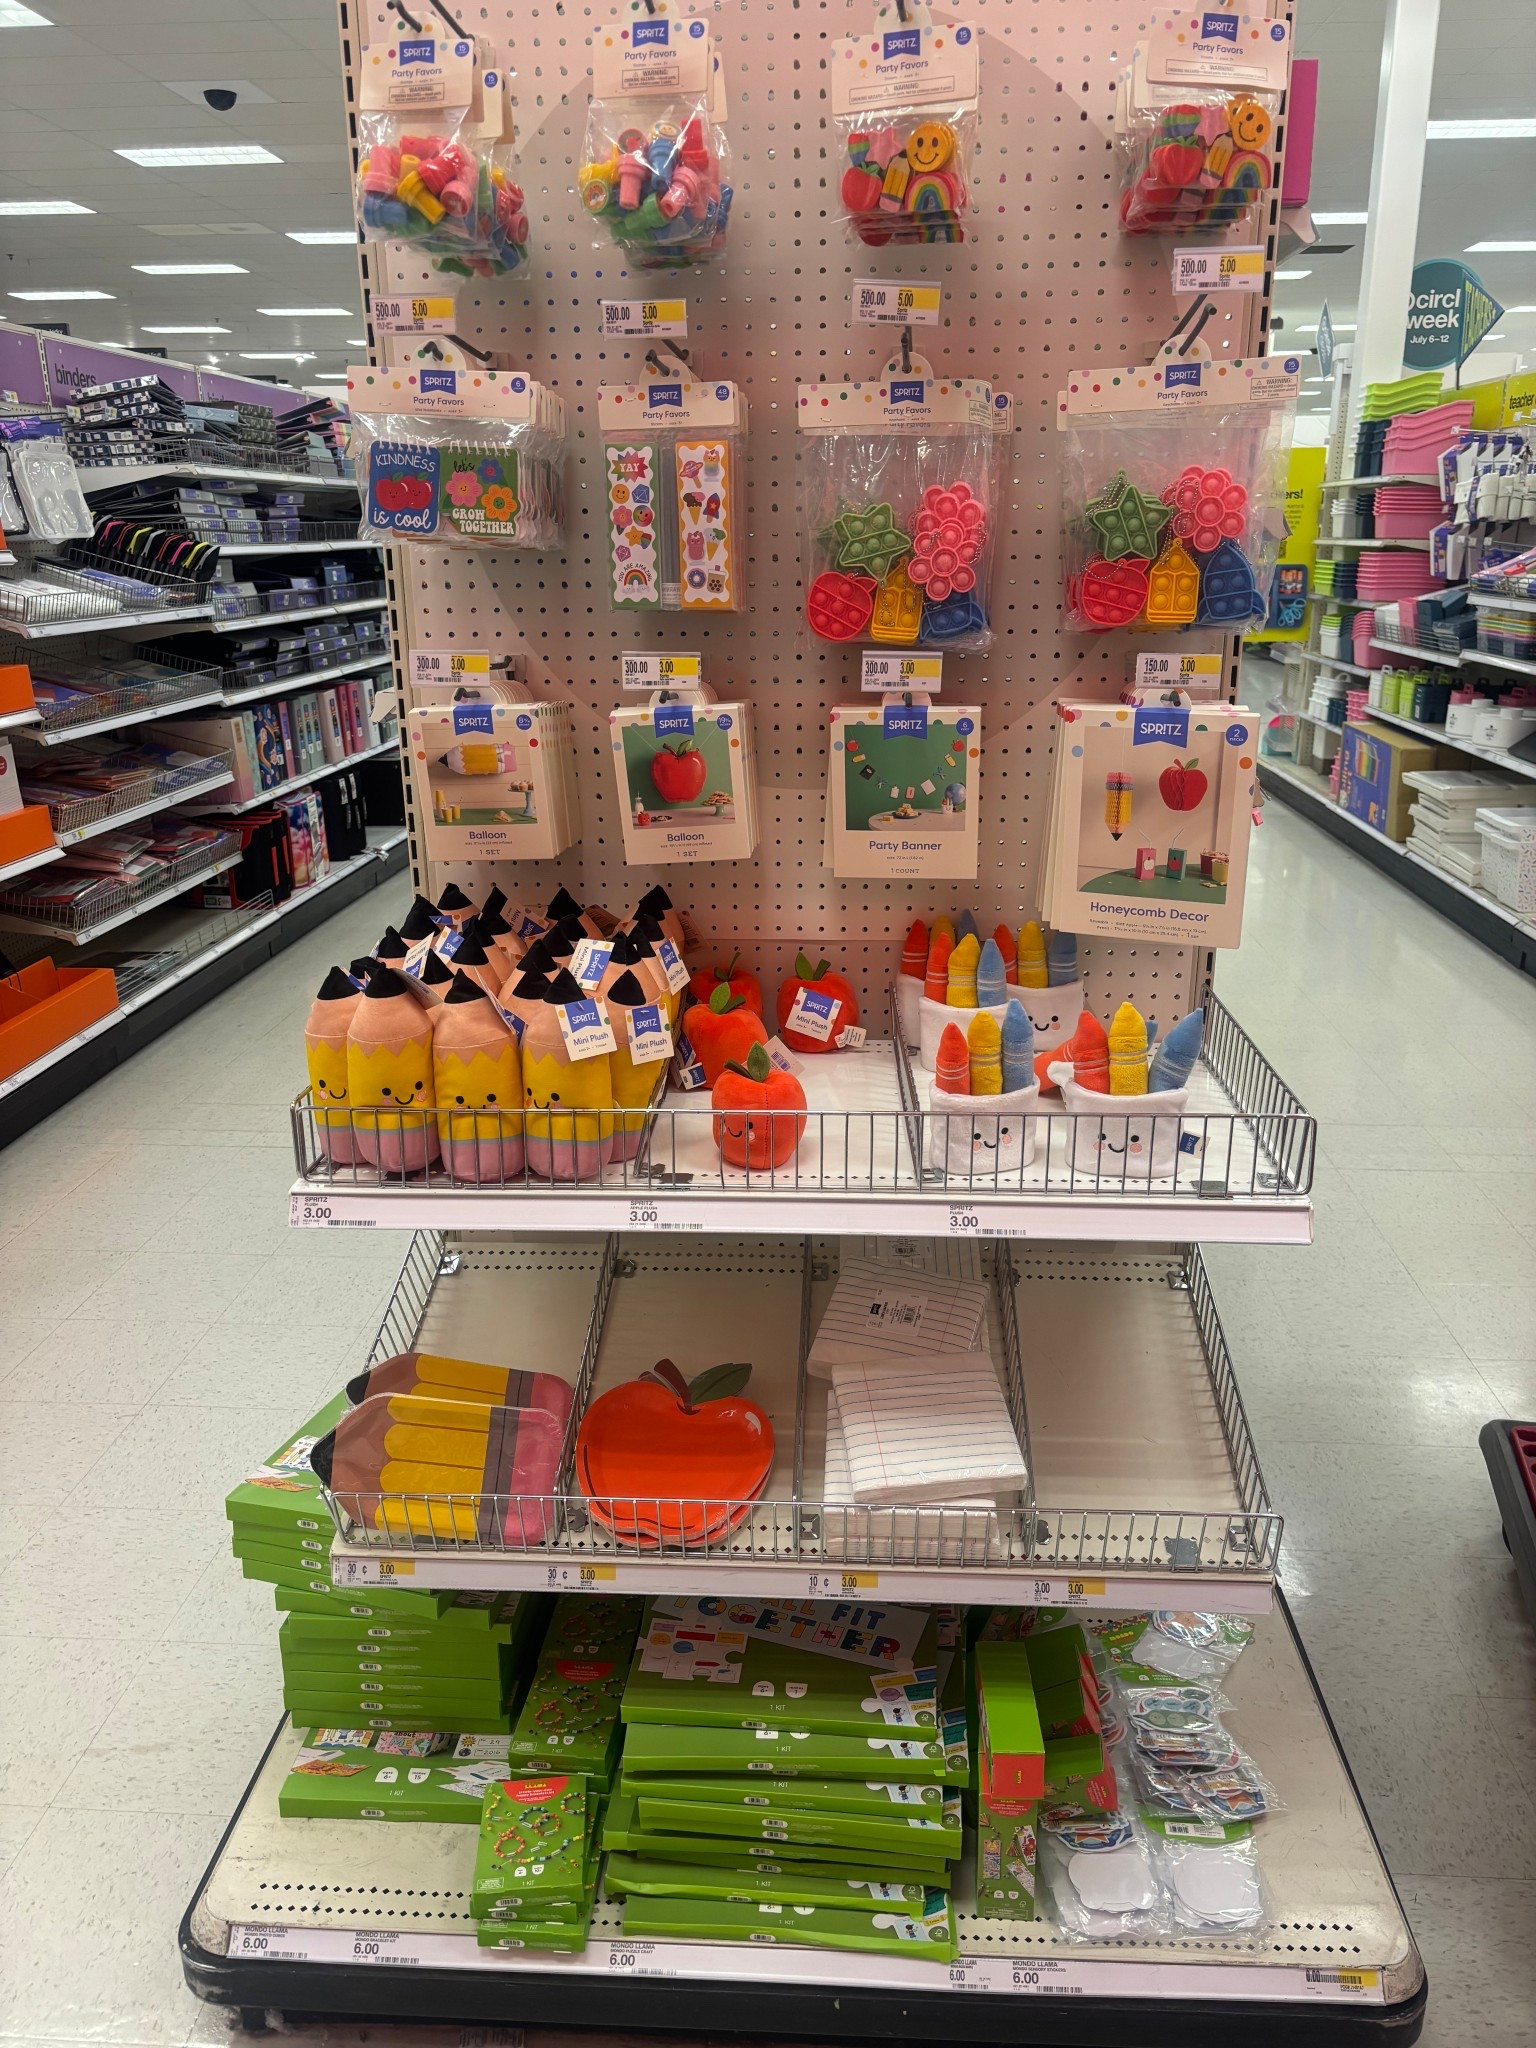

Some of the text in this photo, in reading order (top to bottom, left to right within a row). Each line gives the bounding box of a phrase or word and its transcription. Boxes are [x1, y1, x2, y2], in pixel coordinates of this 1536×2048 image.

[636, 27, 664, 38] SPRITZ
[1206, 21, 1235, 32] SPRITZ
[887, 38, 916, 50] SPRITZ
[1192, 42, 1243, 54] Party Favors
[403, 47, 431, 57] SPRITZ
[624, 50, 677, 61] Party Favors
[875, 60, 929, 74] Party Favors
[391, 68, 442, 79] Party Favors
[1180, 259, 1236, 273] 500.00 5.00
[860, 291, 913, 307] 500.00 5.00
[1416, 288, 1461, 309] circl
[375, 303, 428, 317] 500.00 5.00
[605, 305, 658, 320] 500.00 5.00
[1406, 310, 1459, 329] week
[1410, 335, 1427, 344] July
[54, 363, 97, 387] binders
[1169, 370, 1198, 381] SPRITZ
[424, 376, 453, 387] SPRITZ
[652, 391, 680, 400] SPRITZ
[893, 387, 920, 397] SPRITZ
[1157, 389, 1208, 401] Party Favors
[413, 396, 464, 407] Party Favors
[1509, 392, 1535, 409] teacher
[642, 410, 690, 421] Party Favors
[883, 406, 931, 415] Party Favors
[375, 453, 436, 473] KINDNESS
[453, 457, 476, 473] let's
[619, 463, 640, 472] YAY
[373, 508, 432, 530] is cool
[452, 508, 485, 521] GROW
[459, 520, 515, 535] TOGETHER
[623, 563, 633, 571] ARE
[635, 563, 652, 582] AMAZING
[417, 657, 465, 670] 300.00 3.00
[625, 661, 674, 674] 300.00 3.00
[865, 662, 914, 674] 300.00 3.00
[1144, 659, 1195, 672] 150.00 3.00
[458, 717, 489, 727] SPRITZ
[659, 718, 690, 729] SPRITZ
[888, 720, 923, 730] SPRITZ
[1140, 722, 1183, 736] SPRITZ
[1234, 729, 1240, 737] 2
[469, 831, 507, 839] Balloon
[667, 832, 705, 842] Balloon
[869, 840, 942, 852] Party Banner
[1090, 901, 1209, 922] Honeycomb Decor
[588, 953, 600, 977] SPRITZ
[806, 1000, 829, 1014] SPRITZ
[572, 1012, 597, 1024] SPRITZ
[636, 1018, 658, 1029] SPRITZ
[796, 1014, 828, 1030] Mini Plush
[573, 1032, 609, 1046] Mini Plush
[636, 1038, 668, 1051] Mini Plush
[303, 1207, 332, 1219] 3.00
[629, 1211, 658, 1222] 3.00
[950, 1215, 979, 1227] 3.00
[347, 1563, 357, 1574] 30
[380, 1564, 394, 1574] 3.00
[547, 1569, 595, 1580] 30 3.00
[809, 1576, 857, 1587] 10 3.00
[1034, 1582, 1084, 1594] 3.00 3.00
[830, 1603, 886, 1630] FIT
[389, 1738, 413, 1748] ME
[243, 1937, 268, 1950] 6.00
[354, 1943, 380, 1954] 6.00
[609, 1954, 635, 1966] 6.00
[950, 1970, 965, 1981] 6.00
[1012, 1972, 1039, 1984] 6.00
